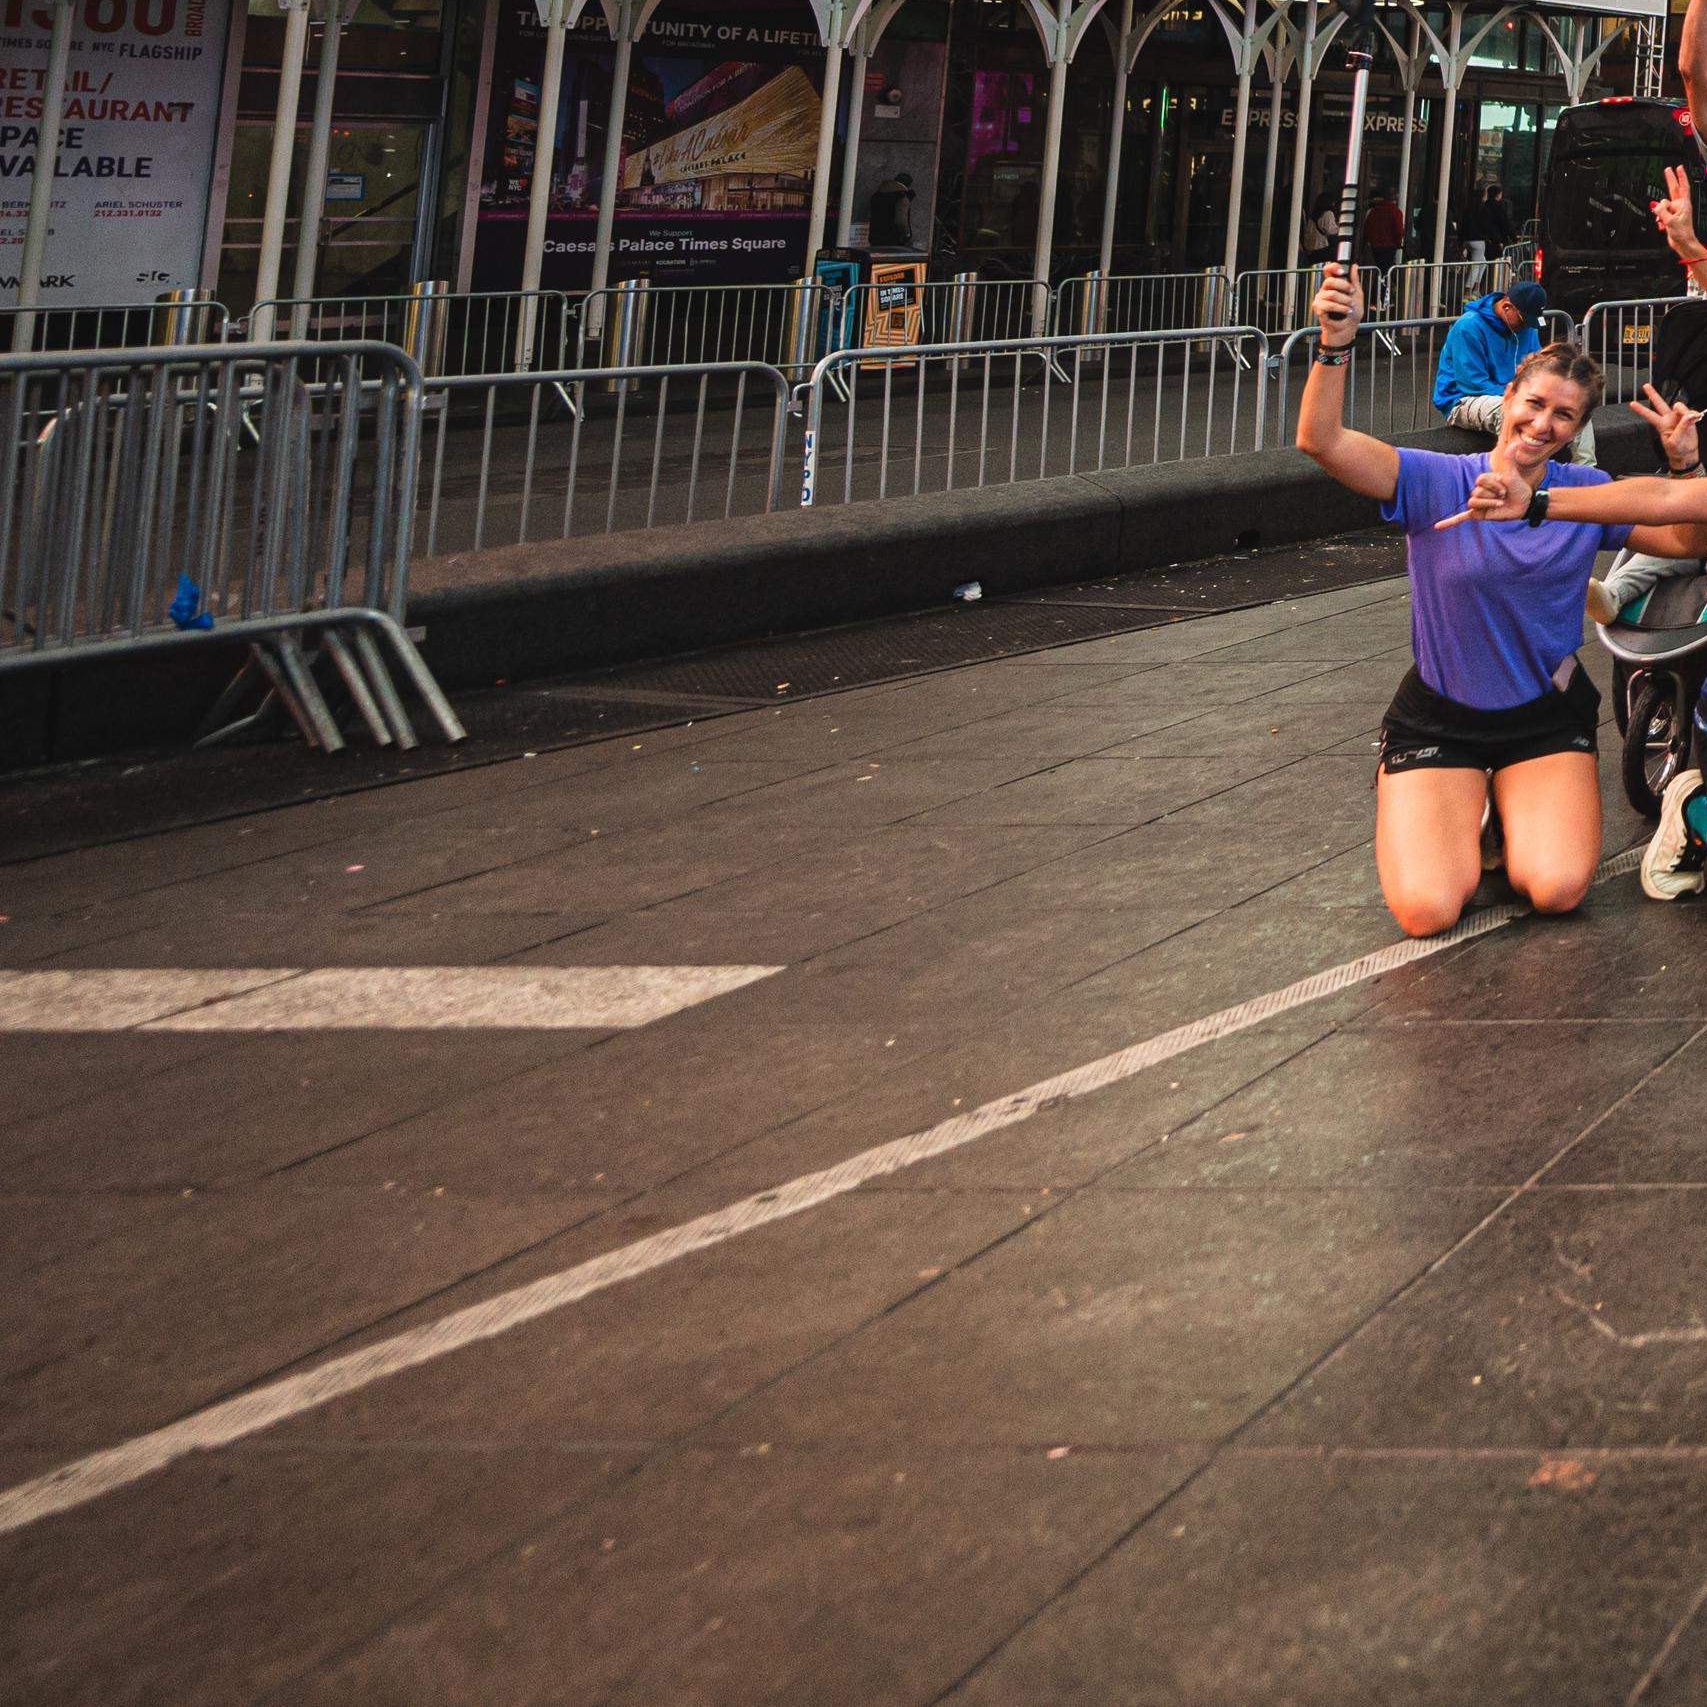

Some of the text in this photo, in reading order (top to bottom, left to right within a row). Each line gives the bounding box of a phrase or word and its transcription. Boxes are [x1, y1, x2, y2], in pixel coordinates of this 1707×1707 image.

[717, 26, 760, 43] OF A
[120, 45, 202, 61] FLAGSHIP
[711, 152, 747, 166] PALACE
[662, 229, 693, 239] Support
[543, 236, 786, 254] Caesas Palace Times Square
